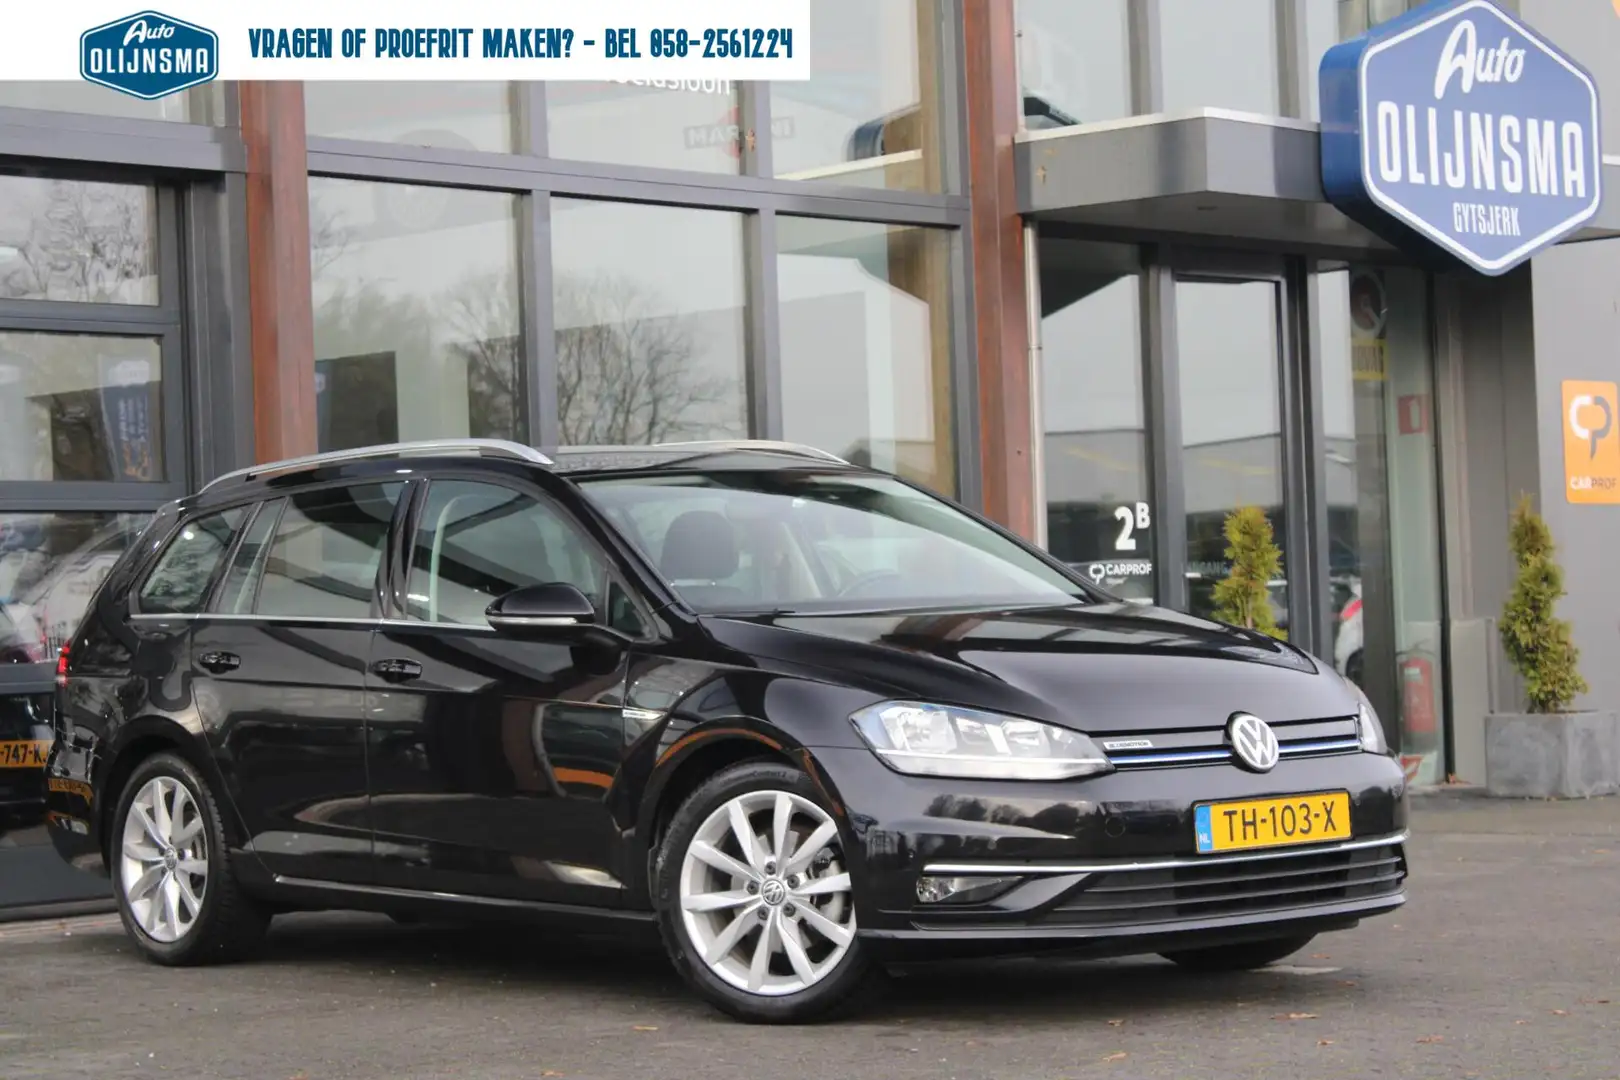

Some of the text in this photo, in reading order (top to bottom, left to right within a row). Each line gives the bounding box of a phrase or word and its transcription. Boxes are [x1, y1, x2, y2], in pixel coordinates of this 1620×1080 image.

[1434, 19, 1526, 100] Auto
[1377, 100, 1586, 198] OLIJNSMA
[1453, 201, 1521, 237] GYTSJERK
[1570, 475, 1618, 491] CARPROF
[1106, 563, 1153, 576] CARPROF
[1198, 832, 1211, 845] NL
[1222, 800, 1337, 842] TH-103-X
